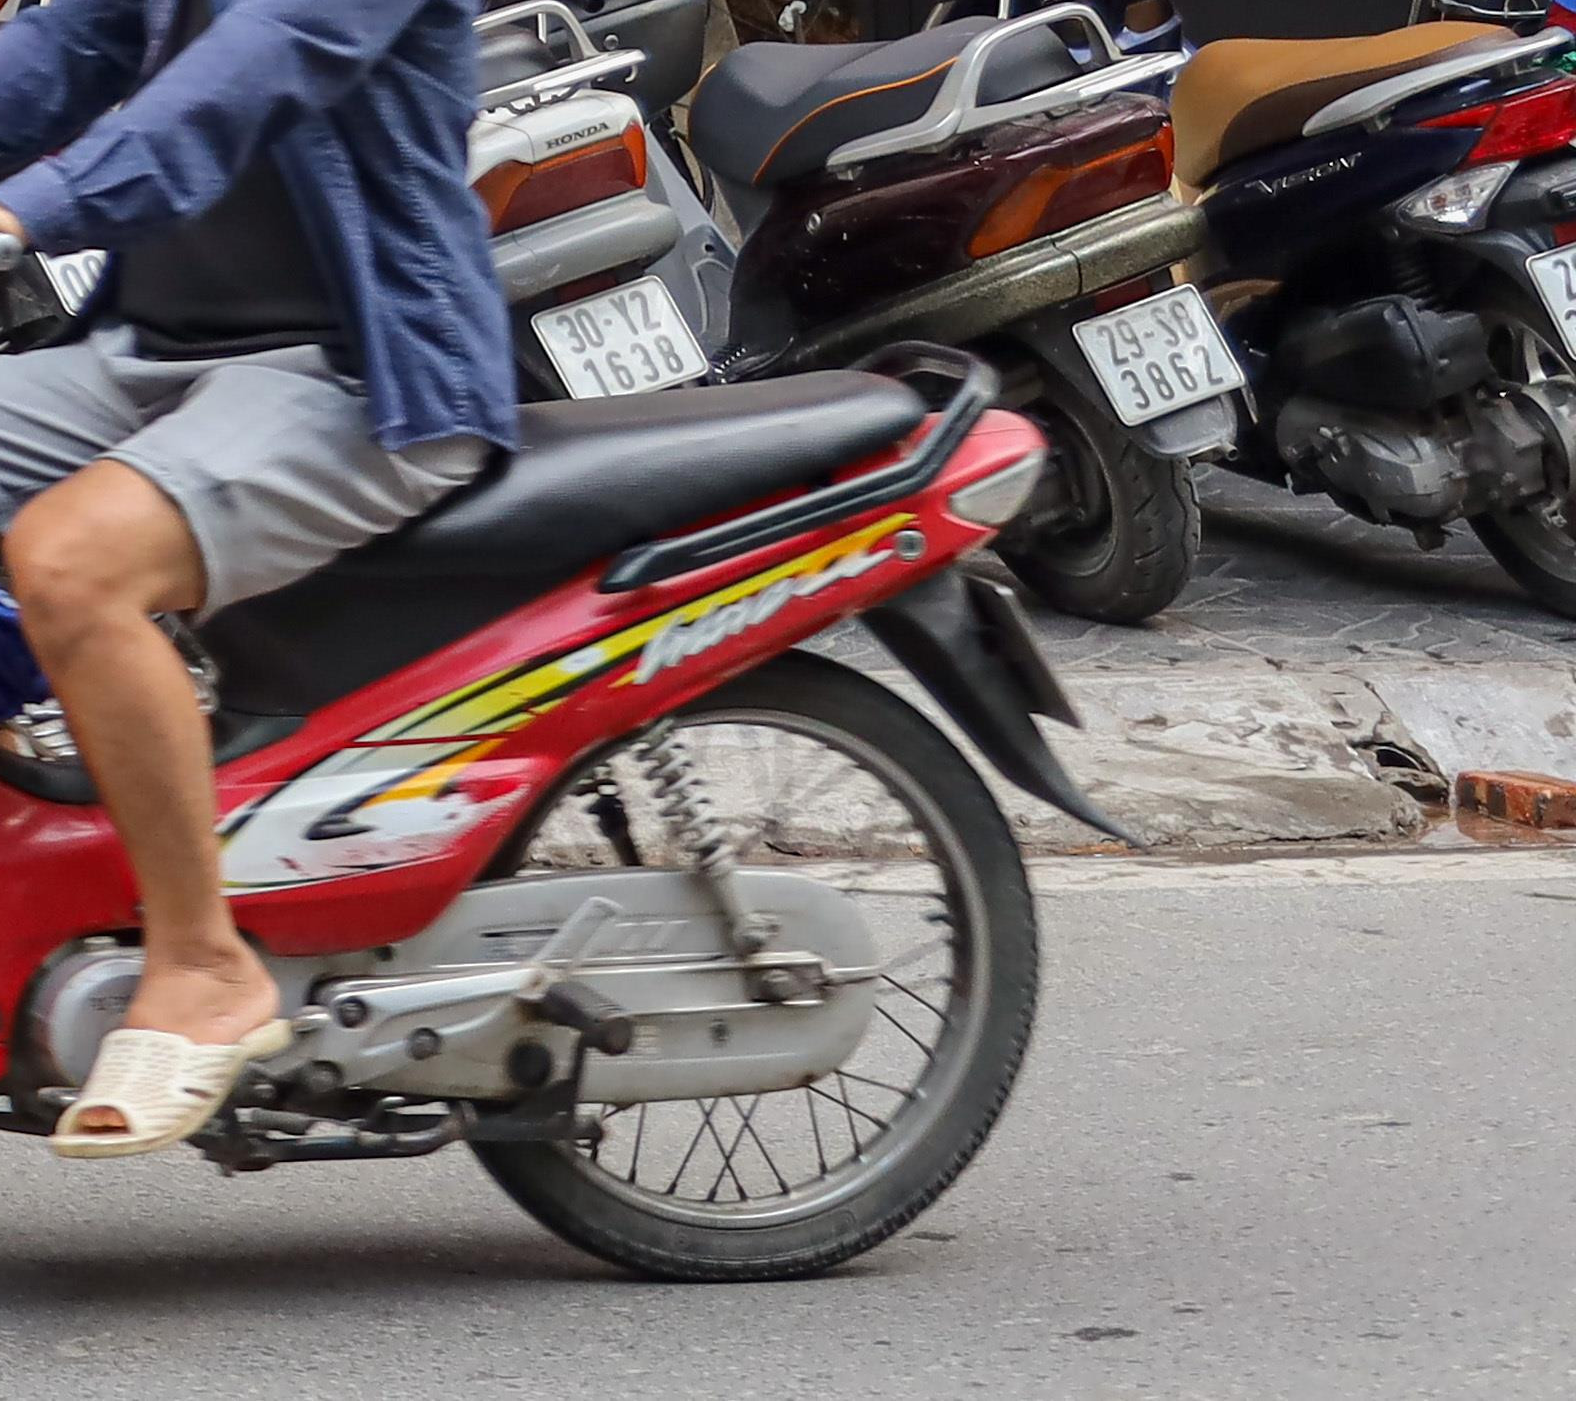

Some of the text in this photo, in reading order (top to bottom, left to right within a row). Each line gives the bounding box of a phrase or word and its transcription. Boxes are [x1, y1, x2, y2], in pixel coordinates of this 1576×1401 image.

[546, 121, 611, 151] HONDA
[555, 290, 662, 355] 30-Y2
[582, 334, 685, 398] 1638
[1120, 345, 1225, 410] 3862
